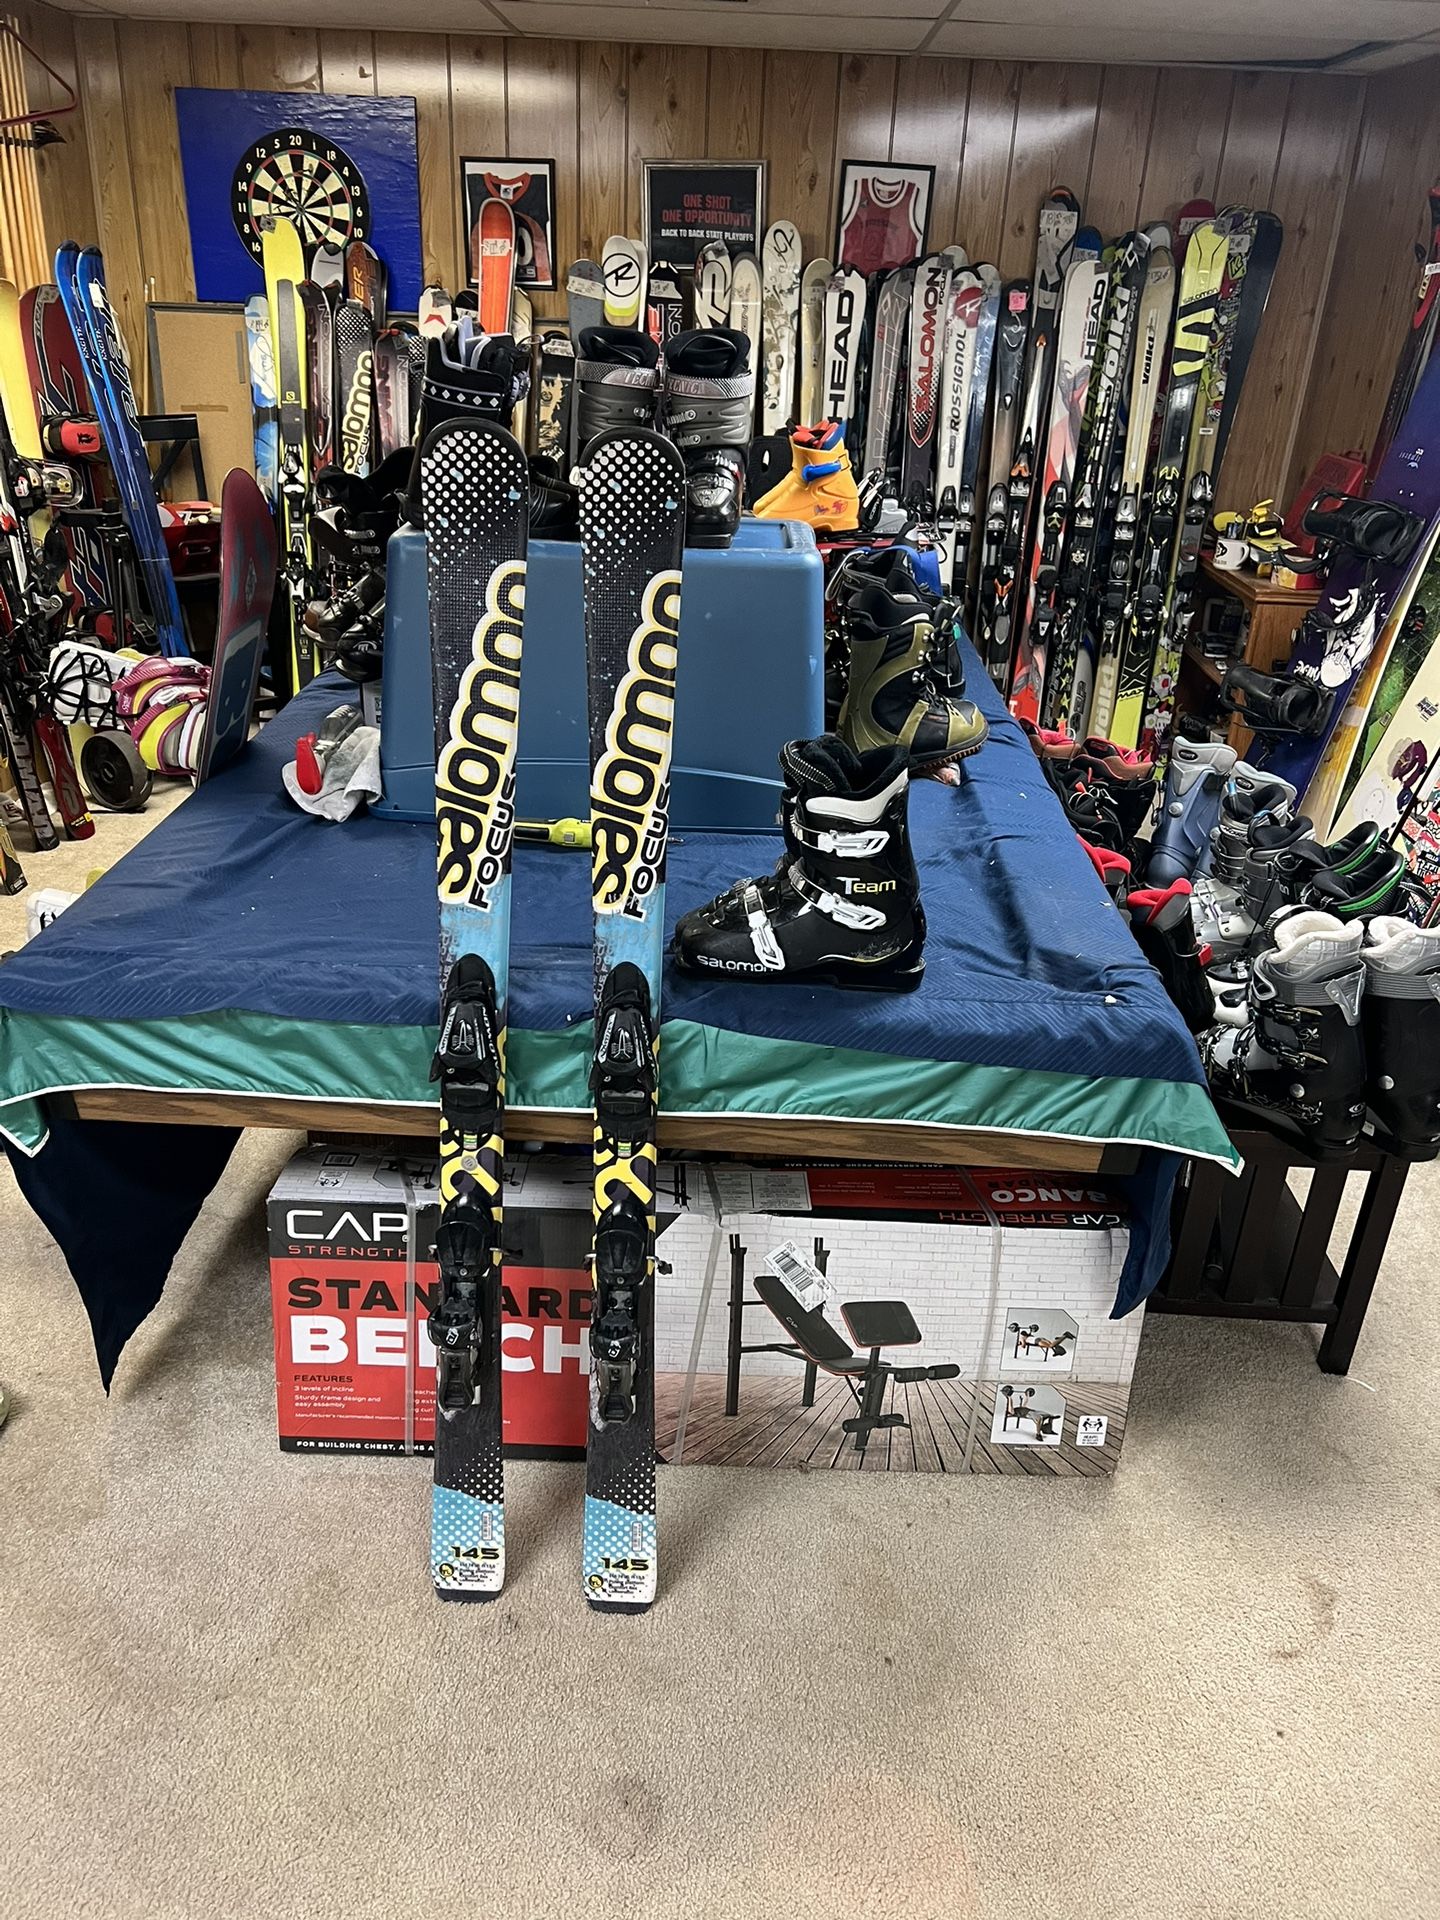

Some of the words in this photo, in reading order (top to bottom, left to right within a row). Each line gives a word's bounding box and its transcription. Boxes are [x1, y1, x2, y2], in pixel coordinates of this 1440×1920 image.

[274, 139, 281, 149] 5
[289, 135, 302, 146] 20
[256, 148, 267, 159] 12
[327, 151, 337, 161] 18
[246, 164, 252, 174] 9
[342, 167, 349, 177] 4
[238, 182, 248, 192] 14
[351, 185, 361, 196] 13
[238, 203, 248, 213] 11
[683, 194, 703, 208] ONE
[705, 194, 731, 209] SHOT
[356, 207, 363, 217] 6
[662, 209, 681, 222] ONE
[684, 209, 752, 226] OPPORTUNITY
[243, 223, 250, 234] 8
[354, 227, 364, 238] 10
[661, 229, 678, 237] BACK
[679, 229, 688, 237] TO
[688, 229, 705, 238] BACK
[706, 230, 723, 239] STATE
[724, 232, 754, 241] PLAYOFFS
[252, 242, 261, 253] 16
[1084, 279, 1107, 361] HEAD
[916, 267, 942, 413] SALOMON
[938, 270, 947, 305] FOCUS
[827, 291, 856, 423] HEAD
[950, 329, 966, 433] ROSSIGNOL
[343, 353, 372, 472] salomon
[435, 570, 527, 896] salomon
[590, 579, 683, 906] salomon
[468, 773, 516, 909] FOCUS
[623, 782, 671, 919] FOCUS
[836, 876, 896, 895] Team
[991, 1187, 1108, 1203] BANCO
[939, 1211, 1068, 1225] STRENGTH
[1072, 1214, 1120, 1225] CAP
[286, 1209, 410, 1242] CAP
[288, 1244, 411, 1257] STRENGTH
[294, 1394, 319, 1402] Sturdy
[343, 1395, 367, 1403] design
[318, 1441, 362, 1449] BUILDING
[364, 1443, 396, 1451] CHEST,
[451, 1546, 500, 1560] 145
[601, 1556, 650, 1571] 145
